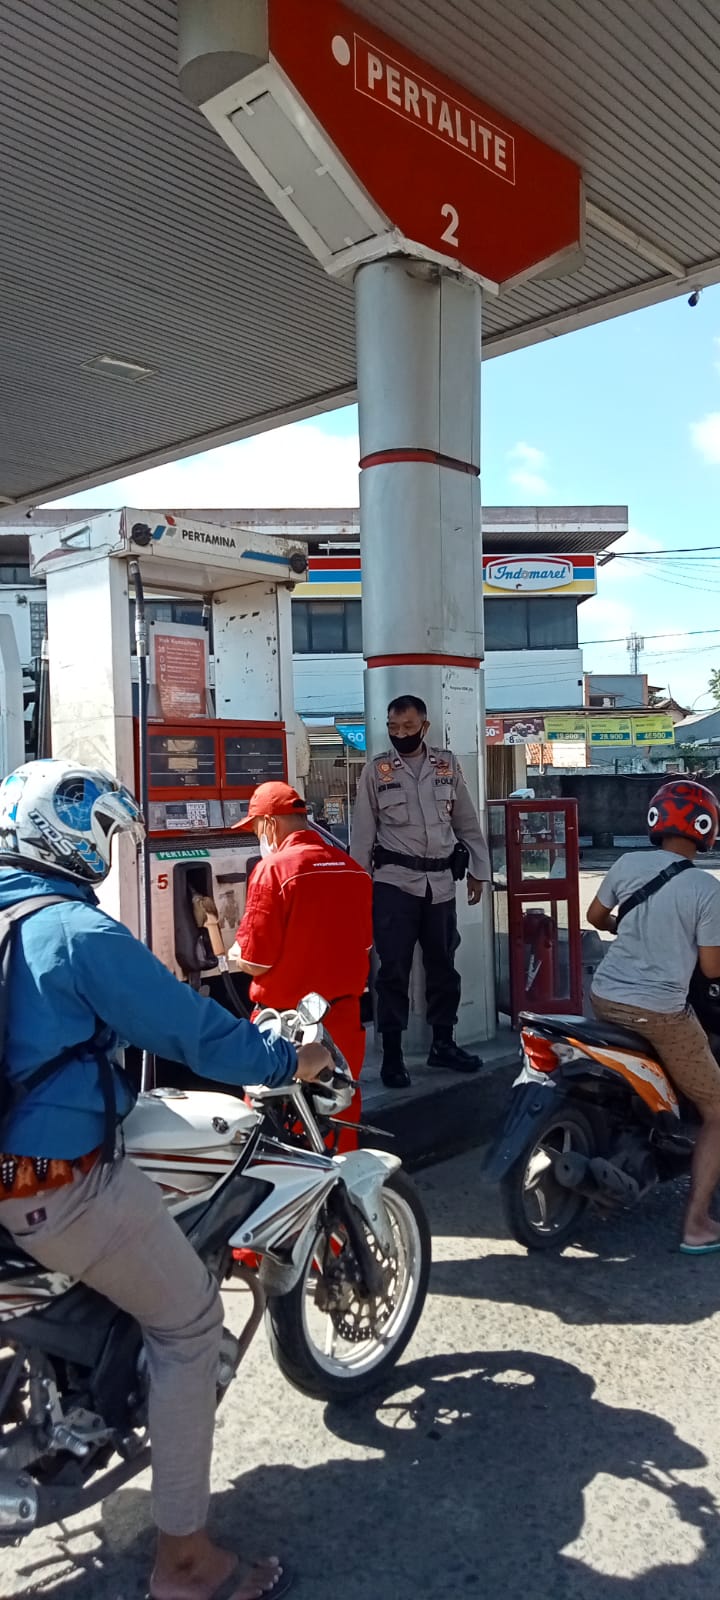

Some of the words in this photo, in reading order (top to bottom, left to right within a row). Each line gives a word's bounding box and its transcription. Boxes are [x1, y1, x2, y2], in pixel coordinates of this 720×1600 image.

[367, 51, 507, 172] PERTALITE
[440, 203, 459, 248] 2
[182, 529, 236, 549] PERTAMINA
[494, 566, 566, 580] Indomaret
[159, 849, 206, 859] PERTALITE
[157, 873, 169, 890] 5
